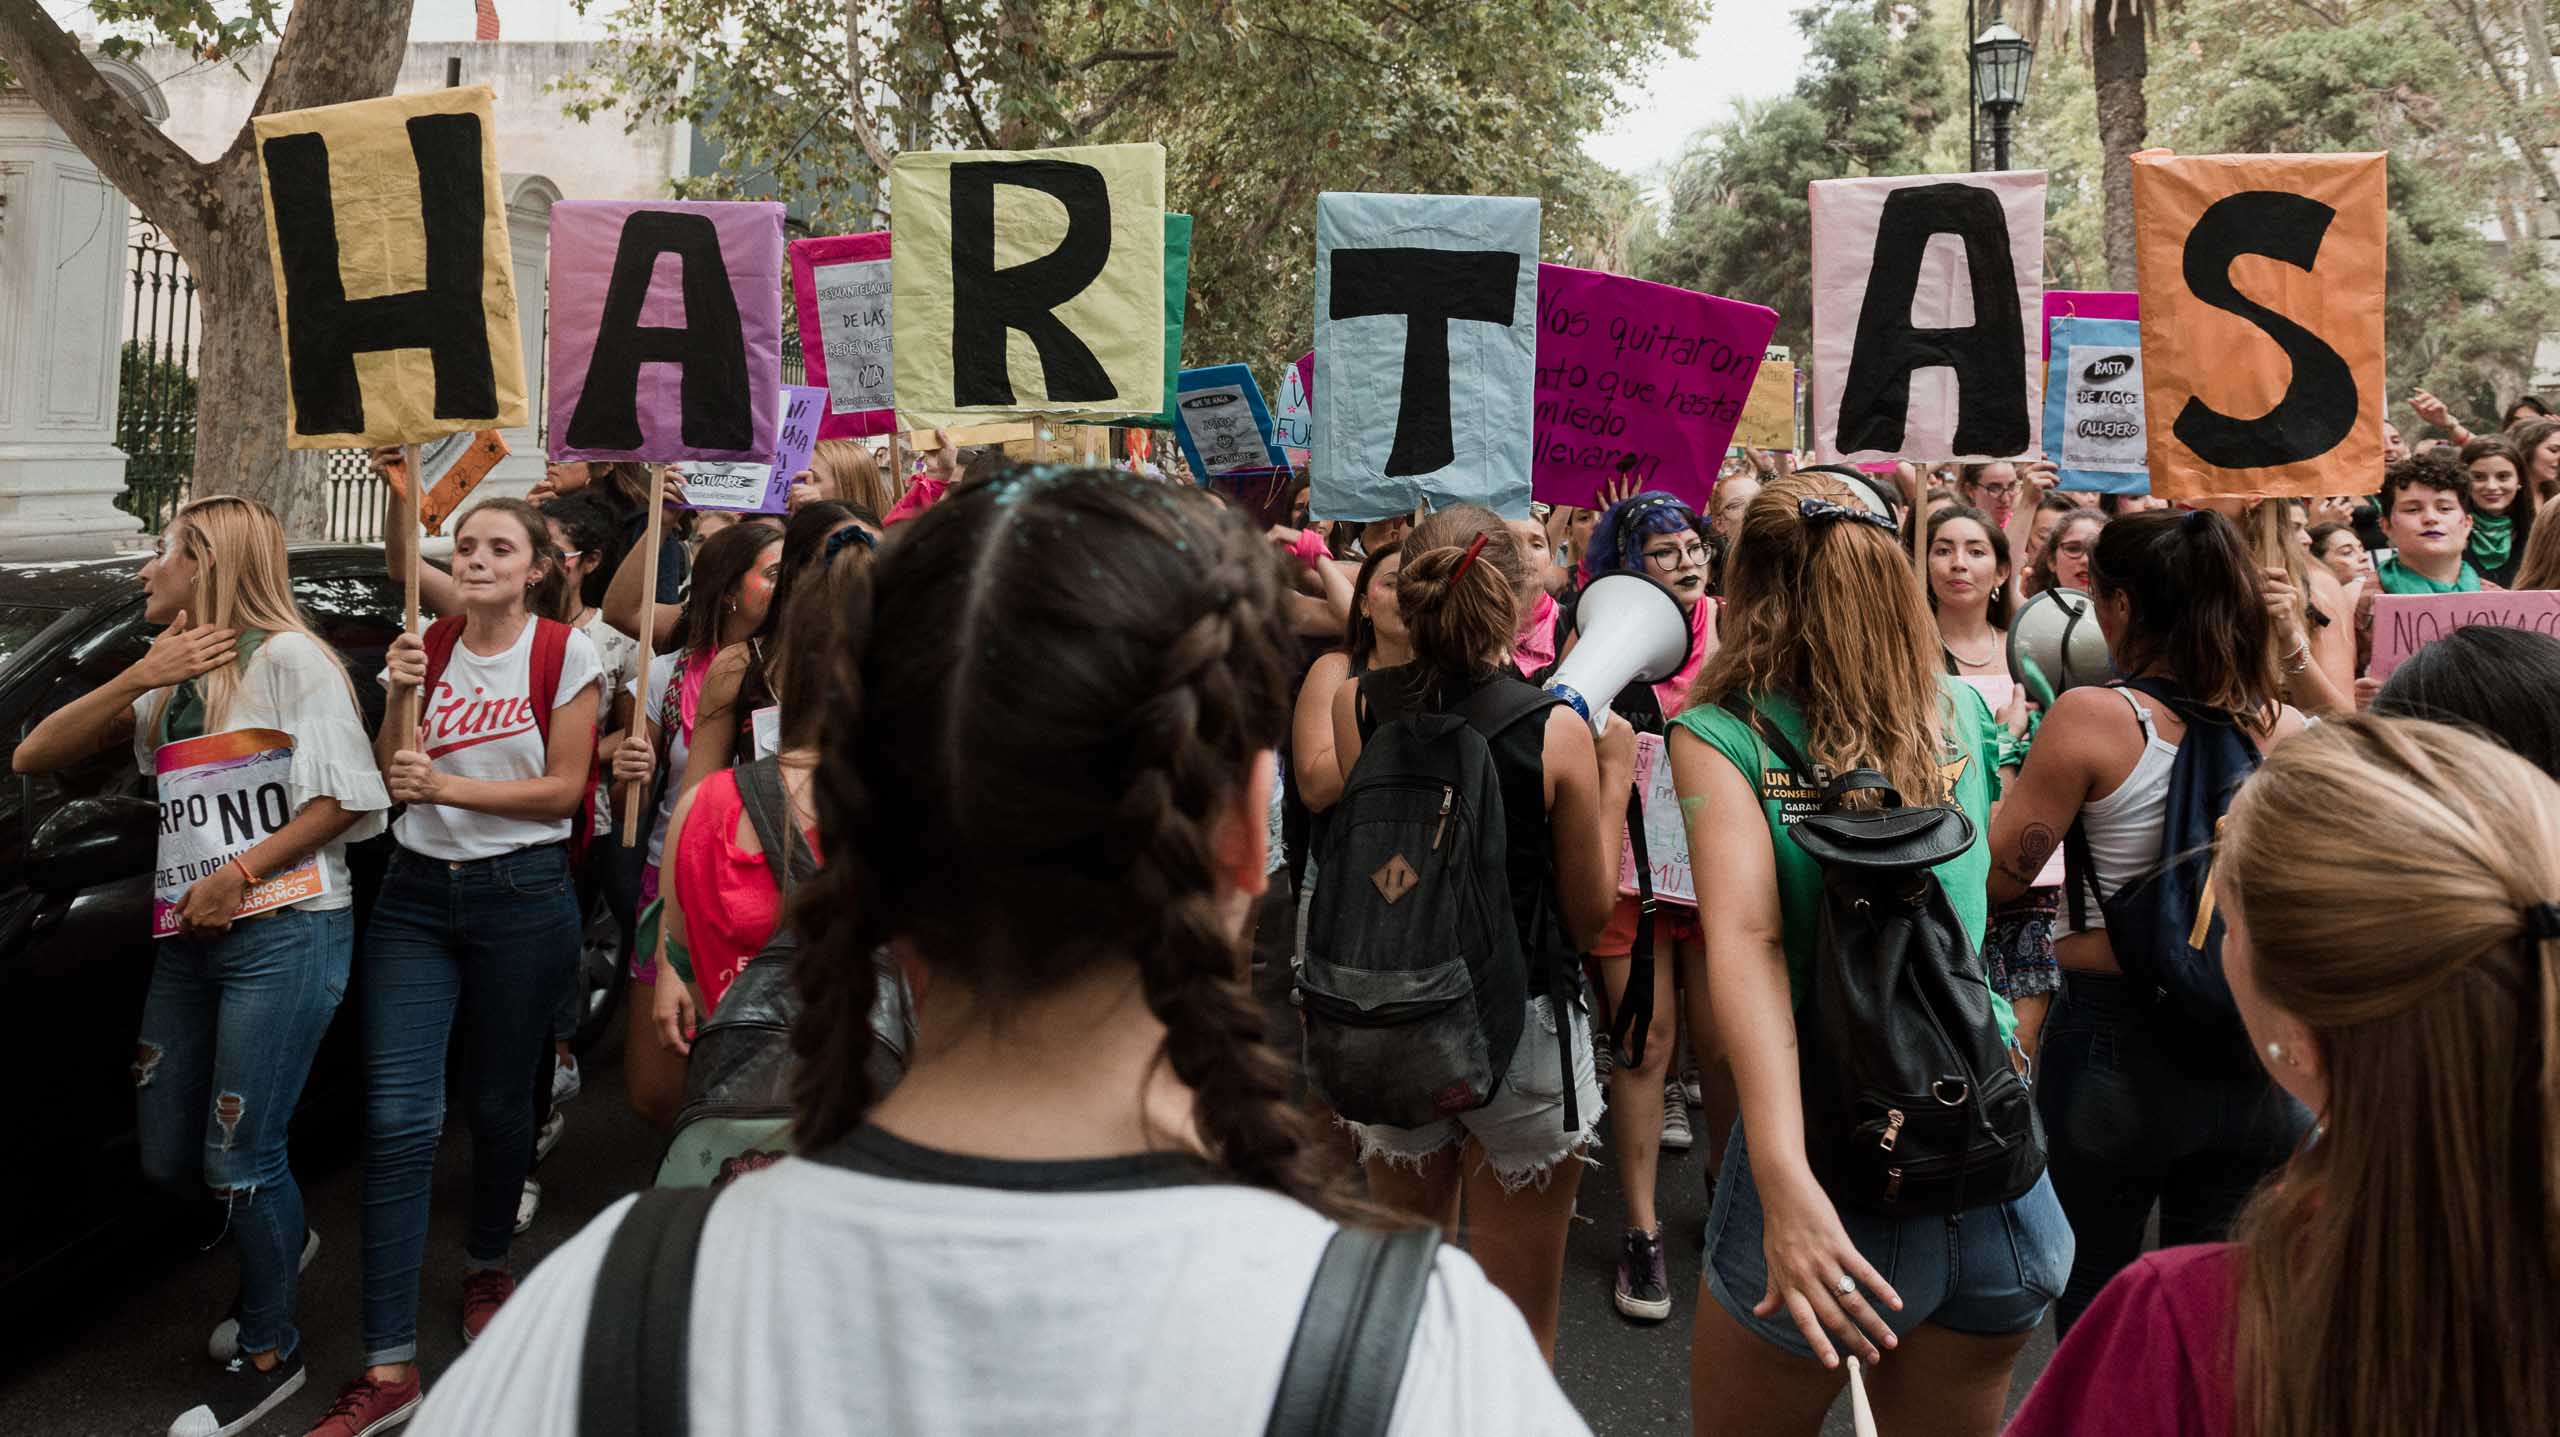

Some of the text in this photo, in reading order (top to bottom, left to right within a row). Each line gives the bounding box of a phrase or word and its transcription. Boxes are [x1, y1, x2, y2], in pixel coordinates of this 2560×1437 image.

[843, 308, 886, 329] DE LAS
[1609, 316, 1753, 381] quitaron
[2094, 361, 2126, 375] BASTA
[1598, 370, 1656, 412] que
[1664, 379, 1742, 424] hasta
[2080, 391, 2134, 404] DE ACOSO
[1535, 396, 1627, 437] miedo
[2079, 420, 2139, 437] CALLEJERO
[1765, 772, 1790, 786] UN
[217, 782, 290, 846] NO
[1784, 803, 1823, 812] GARAN
[176, 863, 198, 883] TU
[238, 884, 308, 911] ARAMOS
